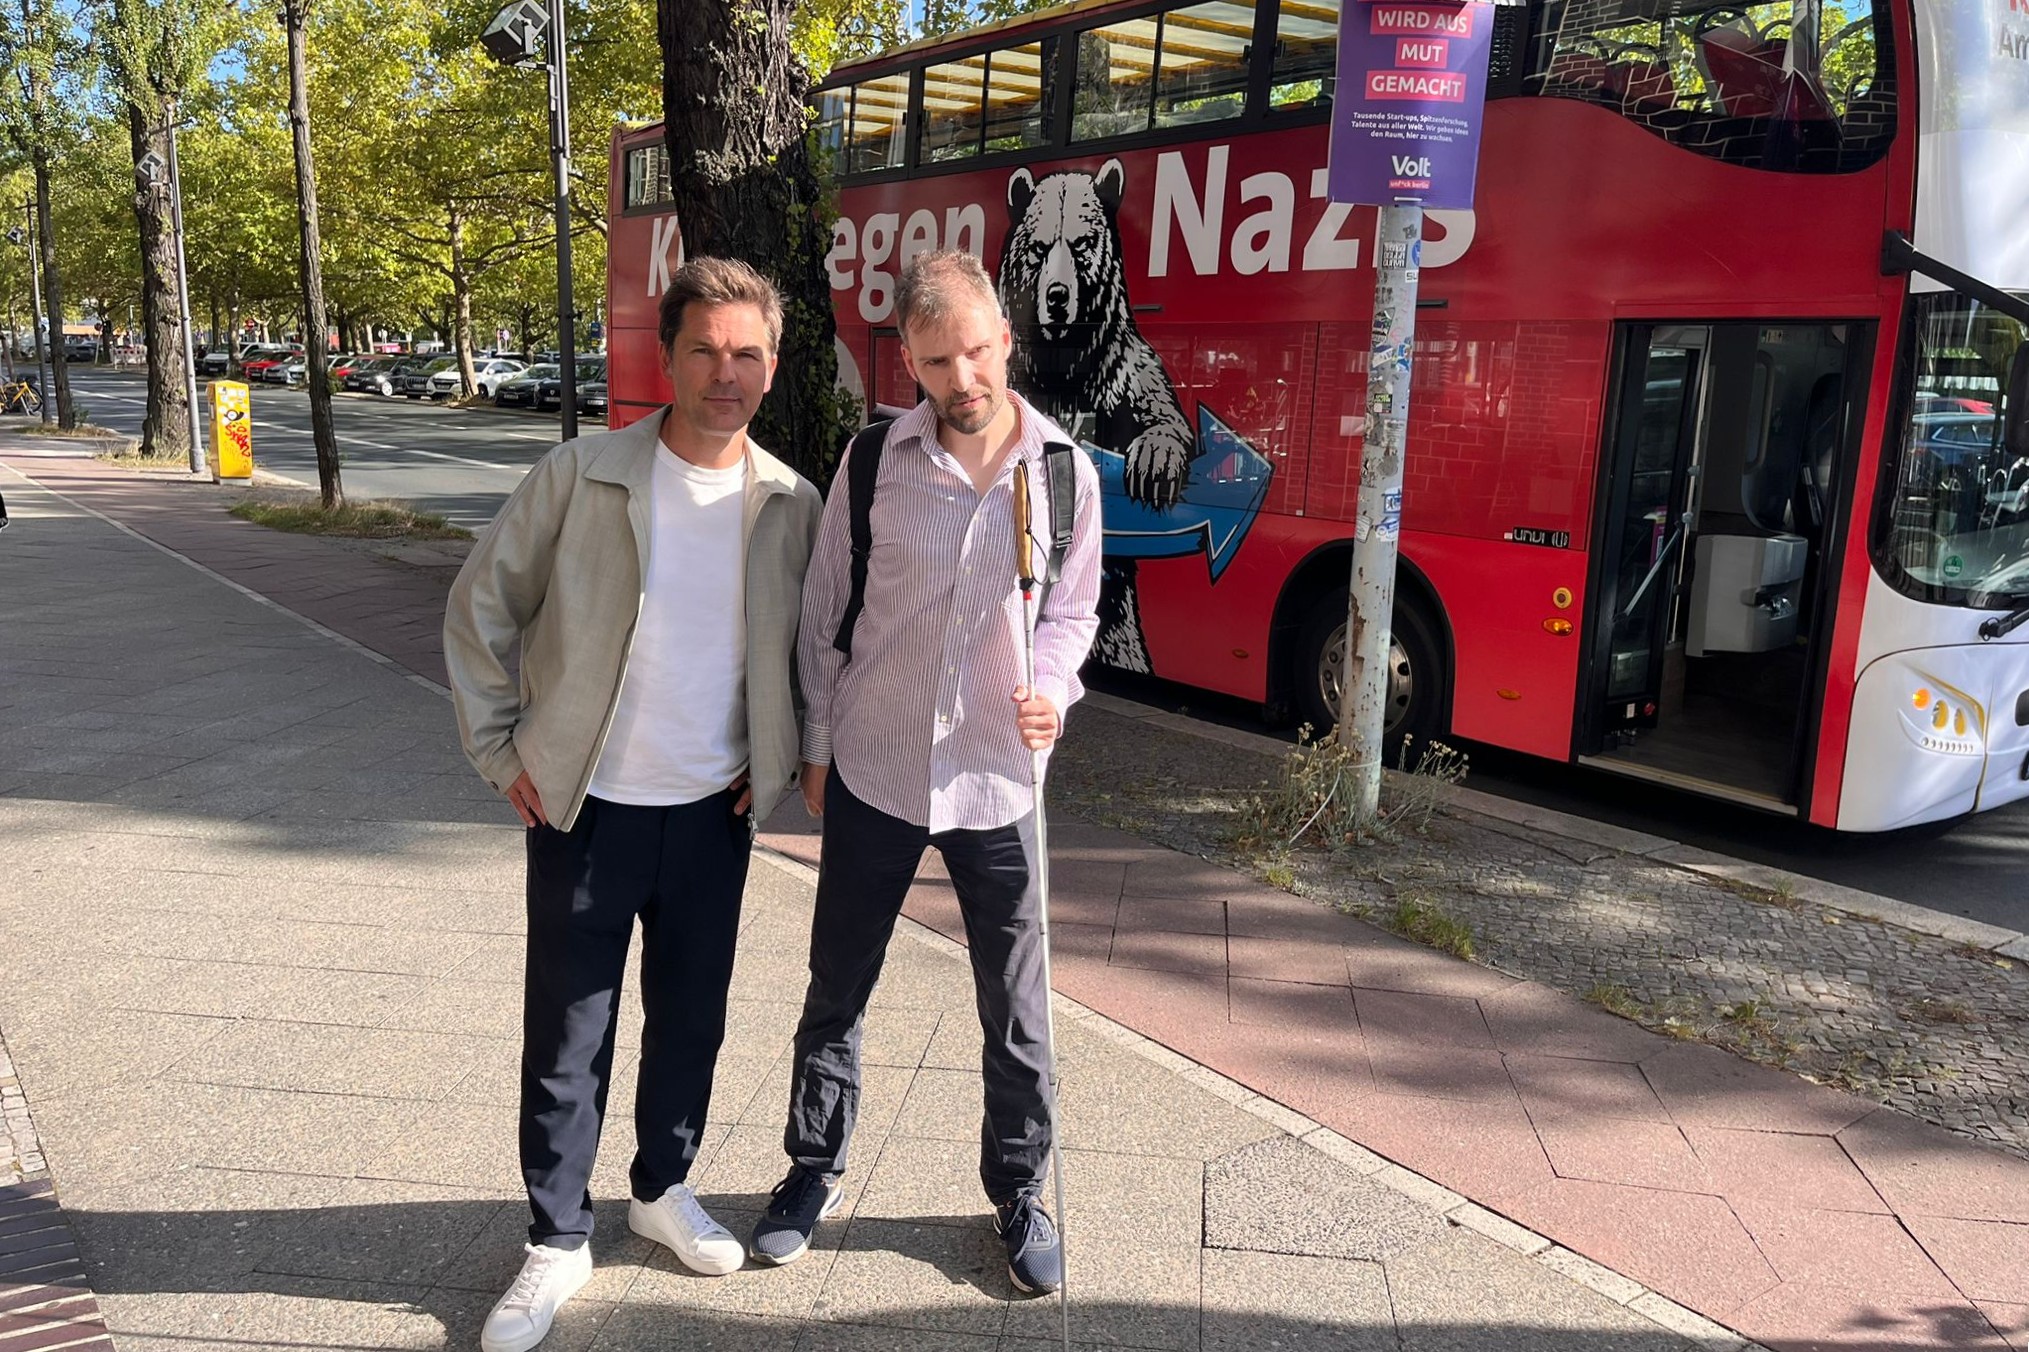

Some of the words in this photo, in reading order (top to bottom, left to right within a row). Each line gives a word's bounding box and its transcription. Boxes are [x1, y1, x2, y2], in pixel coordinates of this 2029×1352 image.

[1377, 9, 1430, 29] WIRD
[1434, 13, 1468, 34] AUS
[1401, 43, 1443, 63] MUT
[1371, 75, 1462, 98] GEMACHT
[1351, 121, 1377, 130] Talente
[1391, 122, 1407, 131] aller
[1408, 123, 1425, 132] Welt.
[1426, 124, 1437, 132] Wir
[1353, 111, 1386, 121] Tausende
[1387, 112, 1419, 122] Start-ups,
[1370, 130, 1384, 138] den
[1385, 131, 1405, 140] Raum,
[1406, 131, 1419, 140] hier
[1391, 155, 1432, 178] Volt
[824, 203, 986, 324] egen
